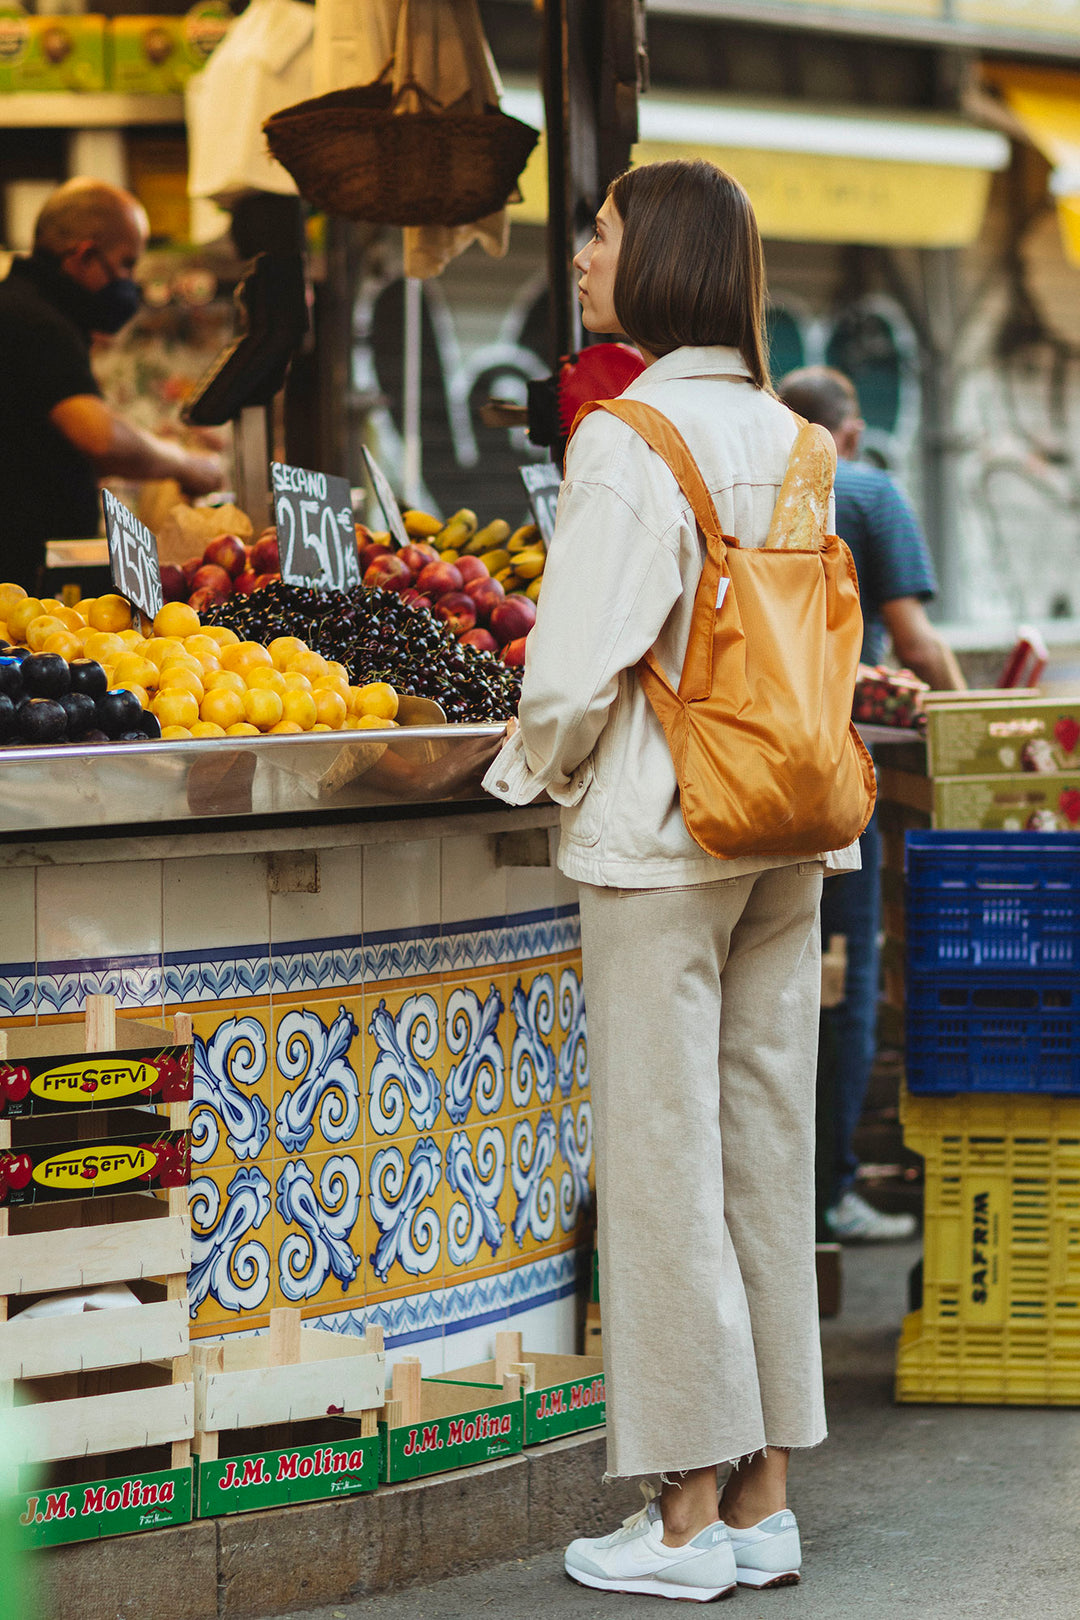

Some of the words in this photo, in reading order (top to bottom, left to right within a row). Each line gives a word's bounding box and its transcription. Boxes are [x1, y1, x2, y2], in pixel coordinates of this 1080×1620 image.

[271, 462, 328, 500] SECANO
[536, 1388, 568, 1419] J.M.
[569, 1378, 606, 1411] Moli
[403, 1424, 444, 1456] J.M.
[446, 1413, 512, 1447] Molina
[219, 1457, 272, 1490] J.M.
[276, 1447, 364, 1482] Molina
[19, 1491, 77, 1525] J.M.
[81, 1479, 175, 1516] Molina
